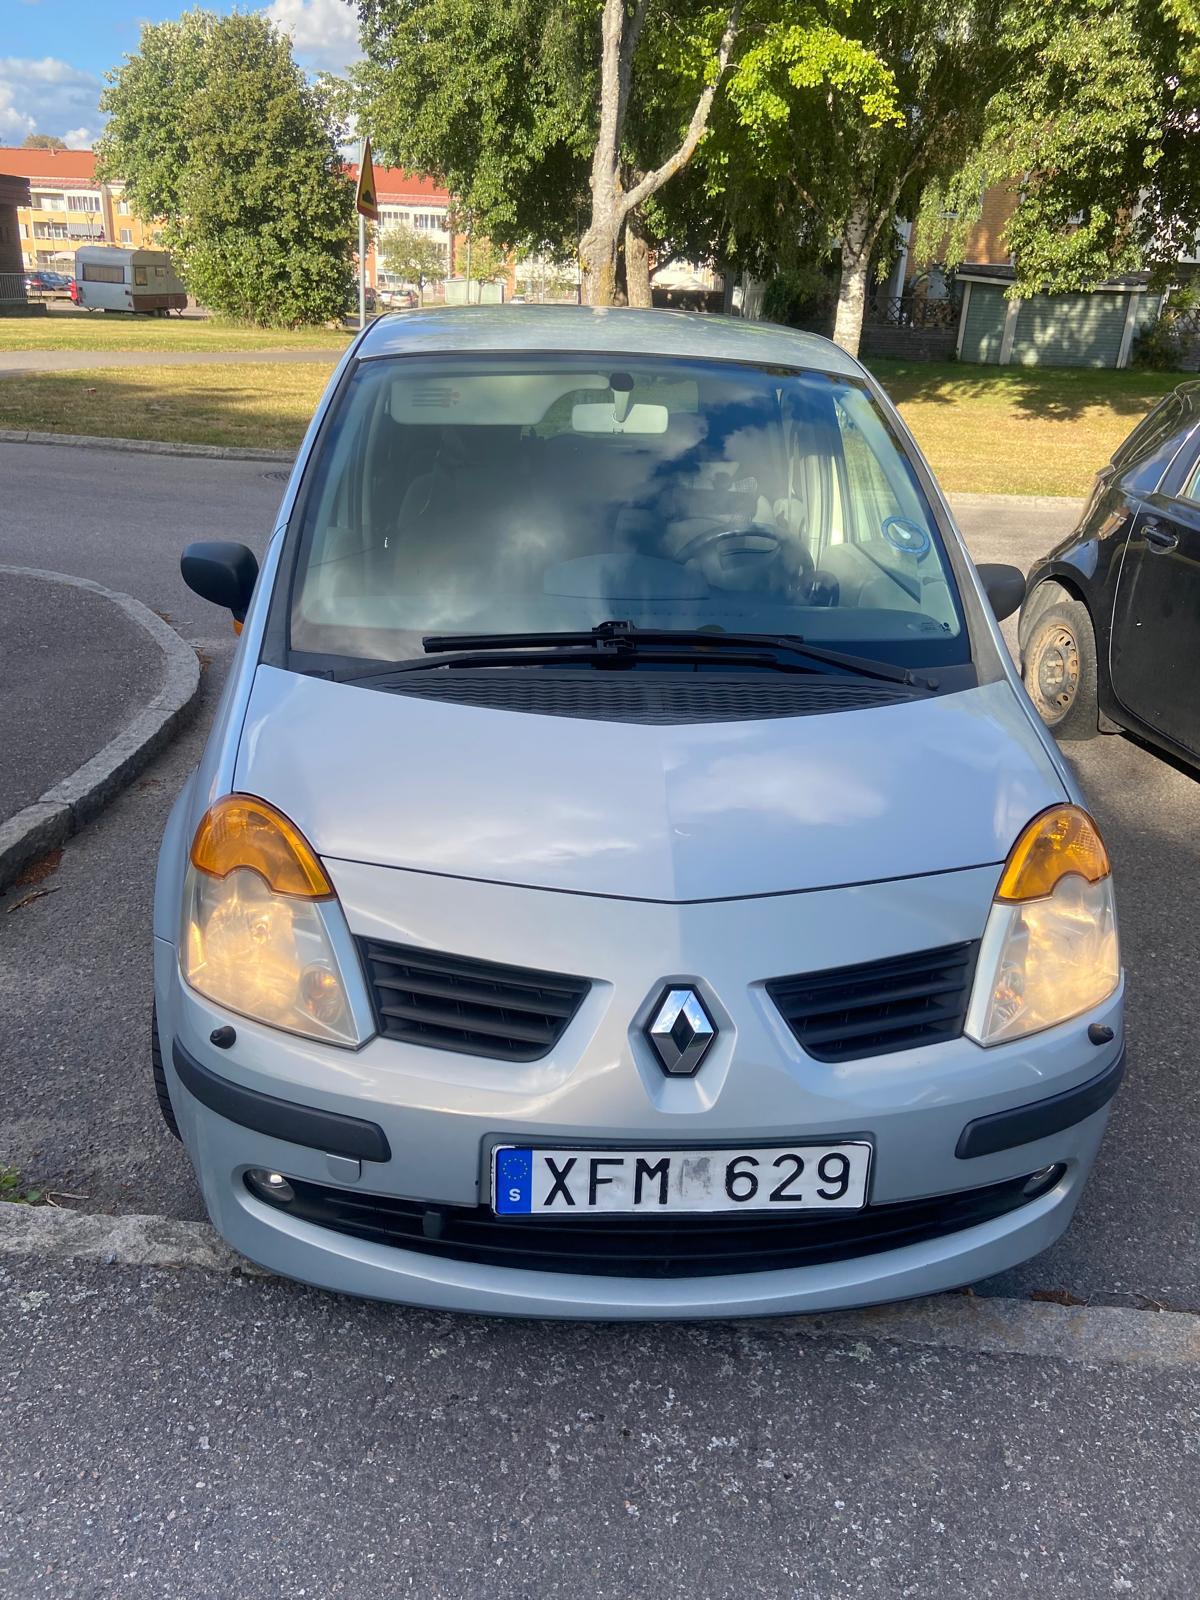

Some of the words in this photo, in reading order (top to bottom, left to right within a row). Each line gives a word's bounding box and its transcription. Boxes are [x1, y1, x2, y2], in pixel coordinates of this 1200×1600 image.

[509, 1188, 521, 1201] S
[543, 1157, 671, 1206] XFM
[725, 1152, 850, 1203] 629
